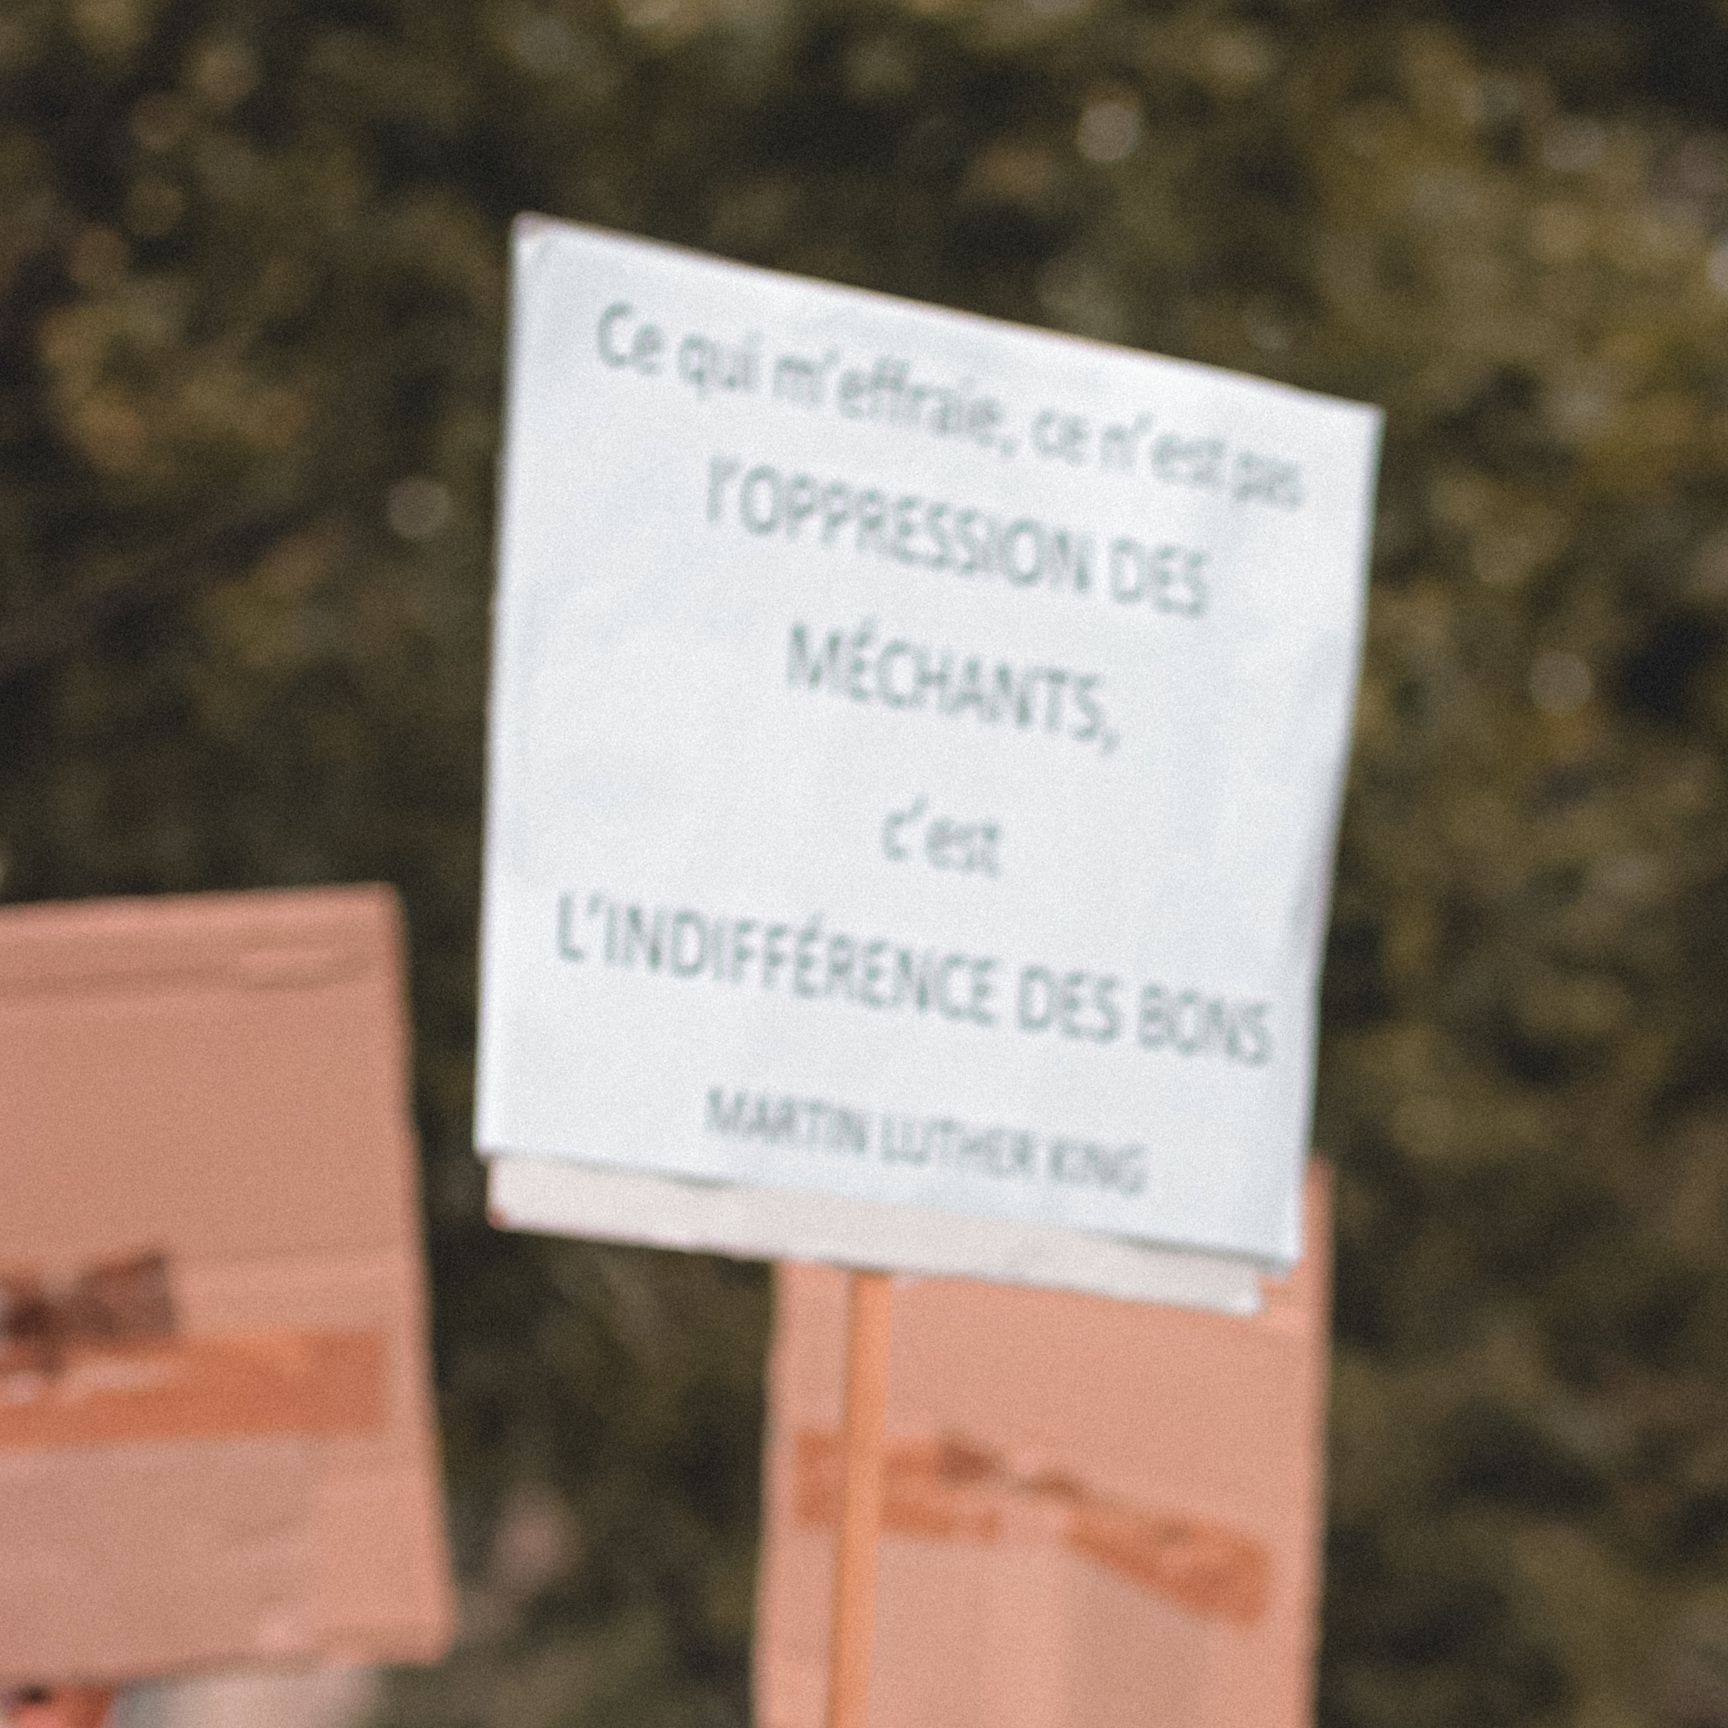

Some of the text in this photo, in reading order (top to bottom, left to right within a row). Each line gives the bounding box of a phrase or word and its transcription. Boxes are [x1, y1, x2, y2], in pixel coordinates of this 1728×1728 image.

[597, 302, 664, 376] Ce
[676, 330, 762, 401] qui
[1032, 408, 1091, 467] ce
[1098, 409, 1228, 491] n'est
[1108, 537, 1209, 619] DES
[786, 615, 1120, 756] MÉCHANTS,
[881, 792, 1002, 882] c'est
[555, 887, 1274, 1067] L'INDIFFÉRENCE DES BONS
[704, 1087, 1149, 1197] MARTIN LUTHER KING
